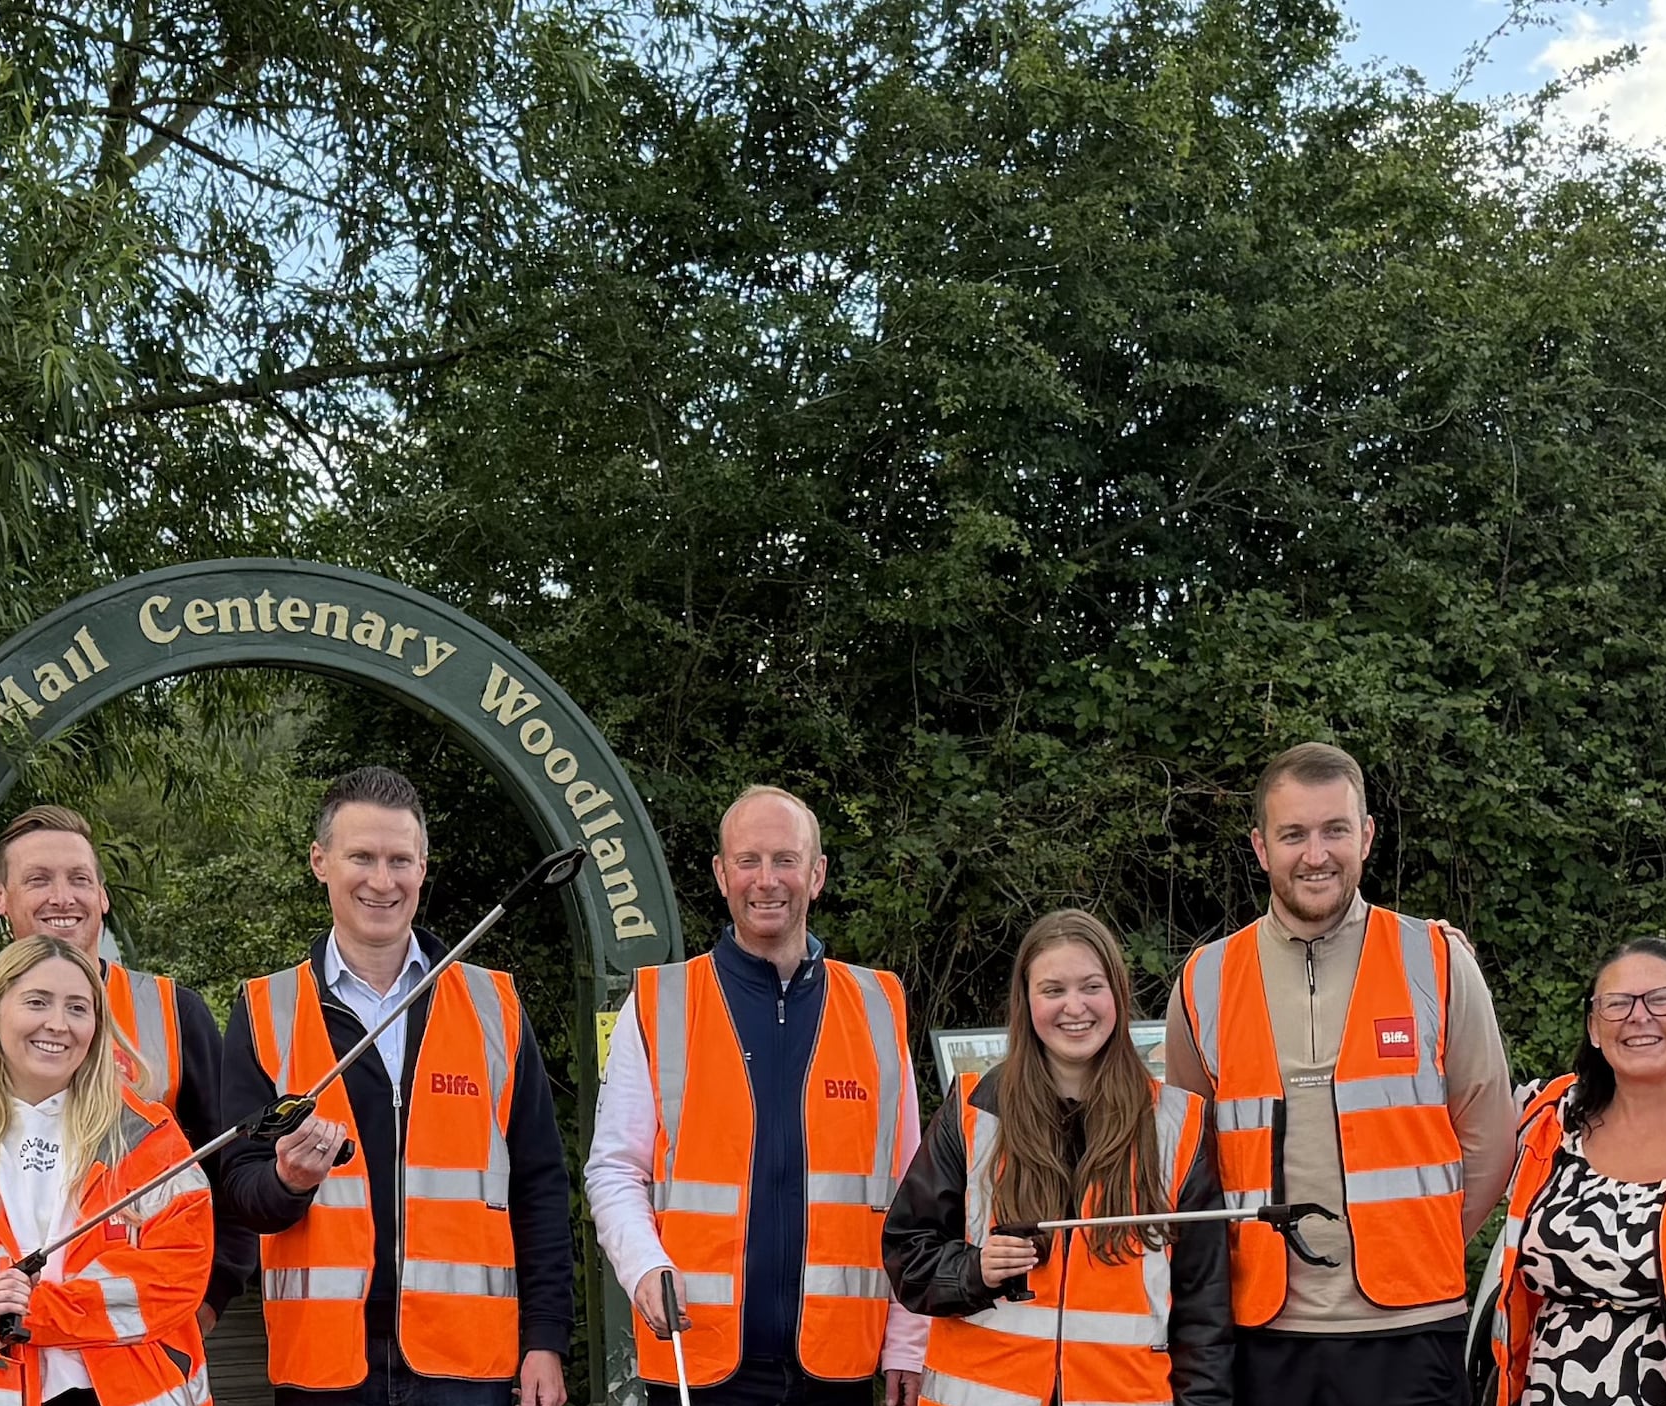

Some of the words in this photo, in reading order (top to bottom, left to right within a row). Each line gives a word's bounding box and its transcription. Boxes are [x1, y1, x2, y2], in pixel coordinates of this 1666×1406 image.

[139, 589, 457, 678] Centenary
[480, 662, 658, 941] Woodland
[1382, 1031, 1409, 1044] Biffa
[431, 1073, 479, 1096] Biffa
[824, 1079, 867, 1101] Biffa
